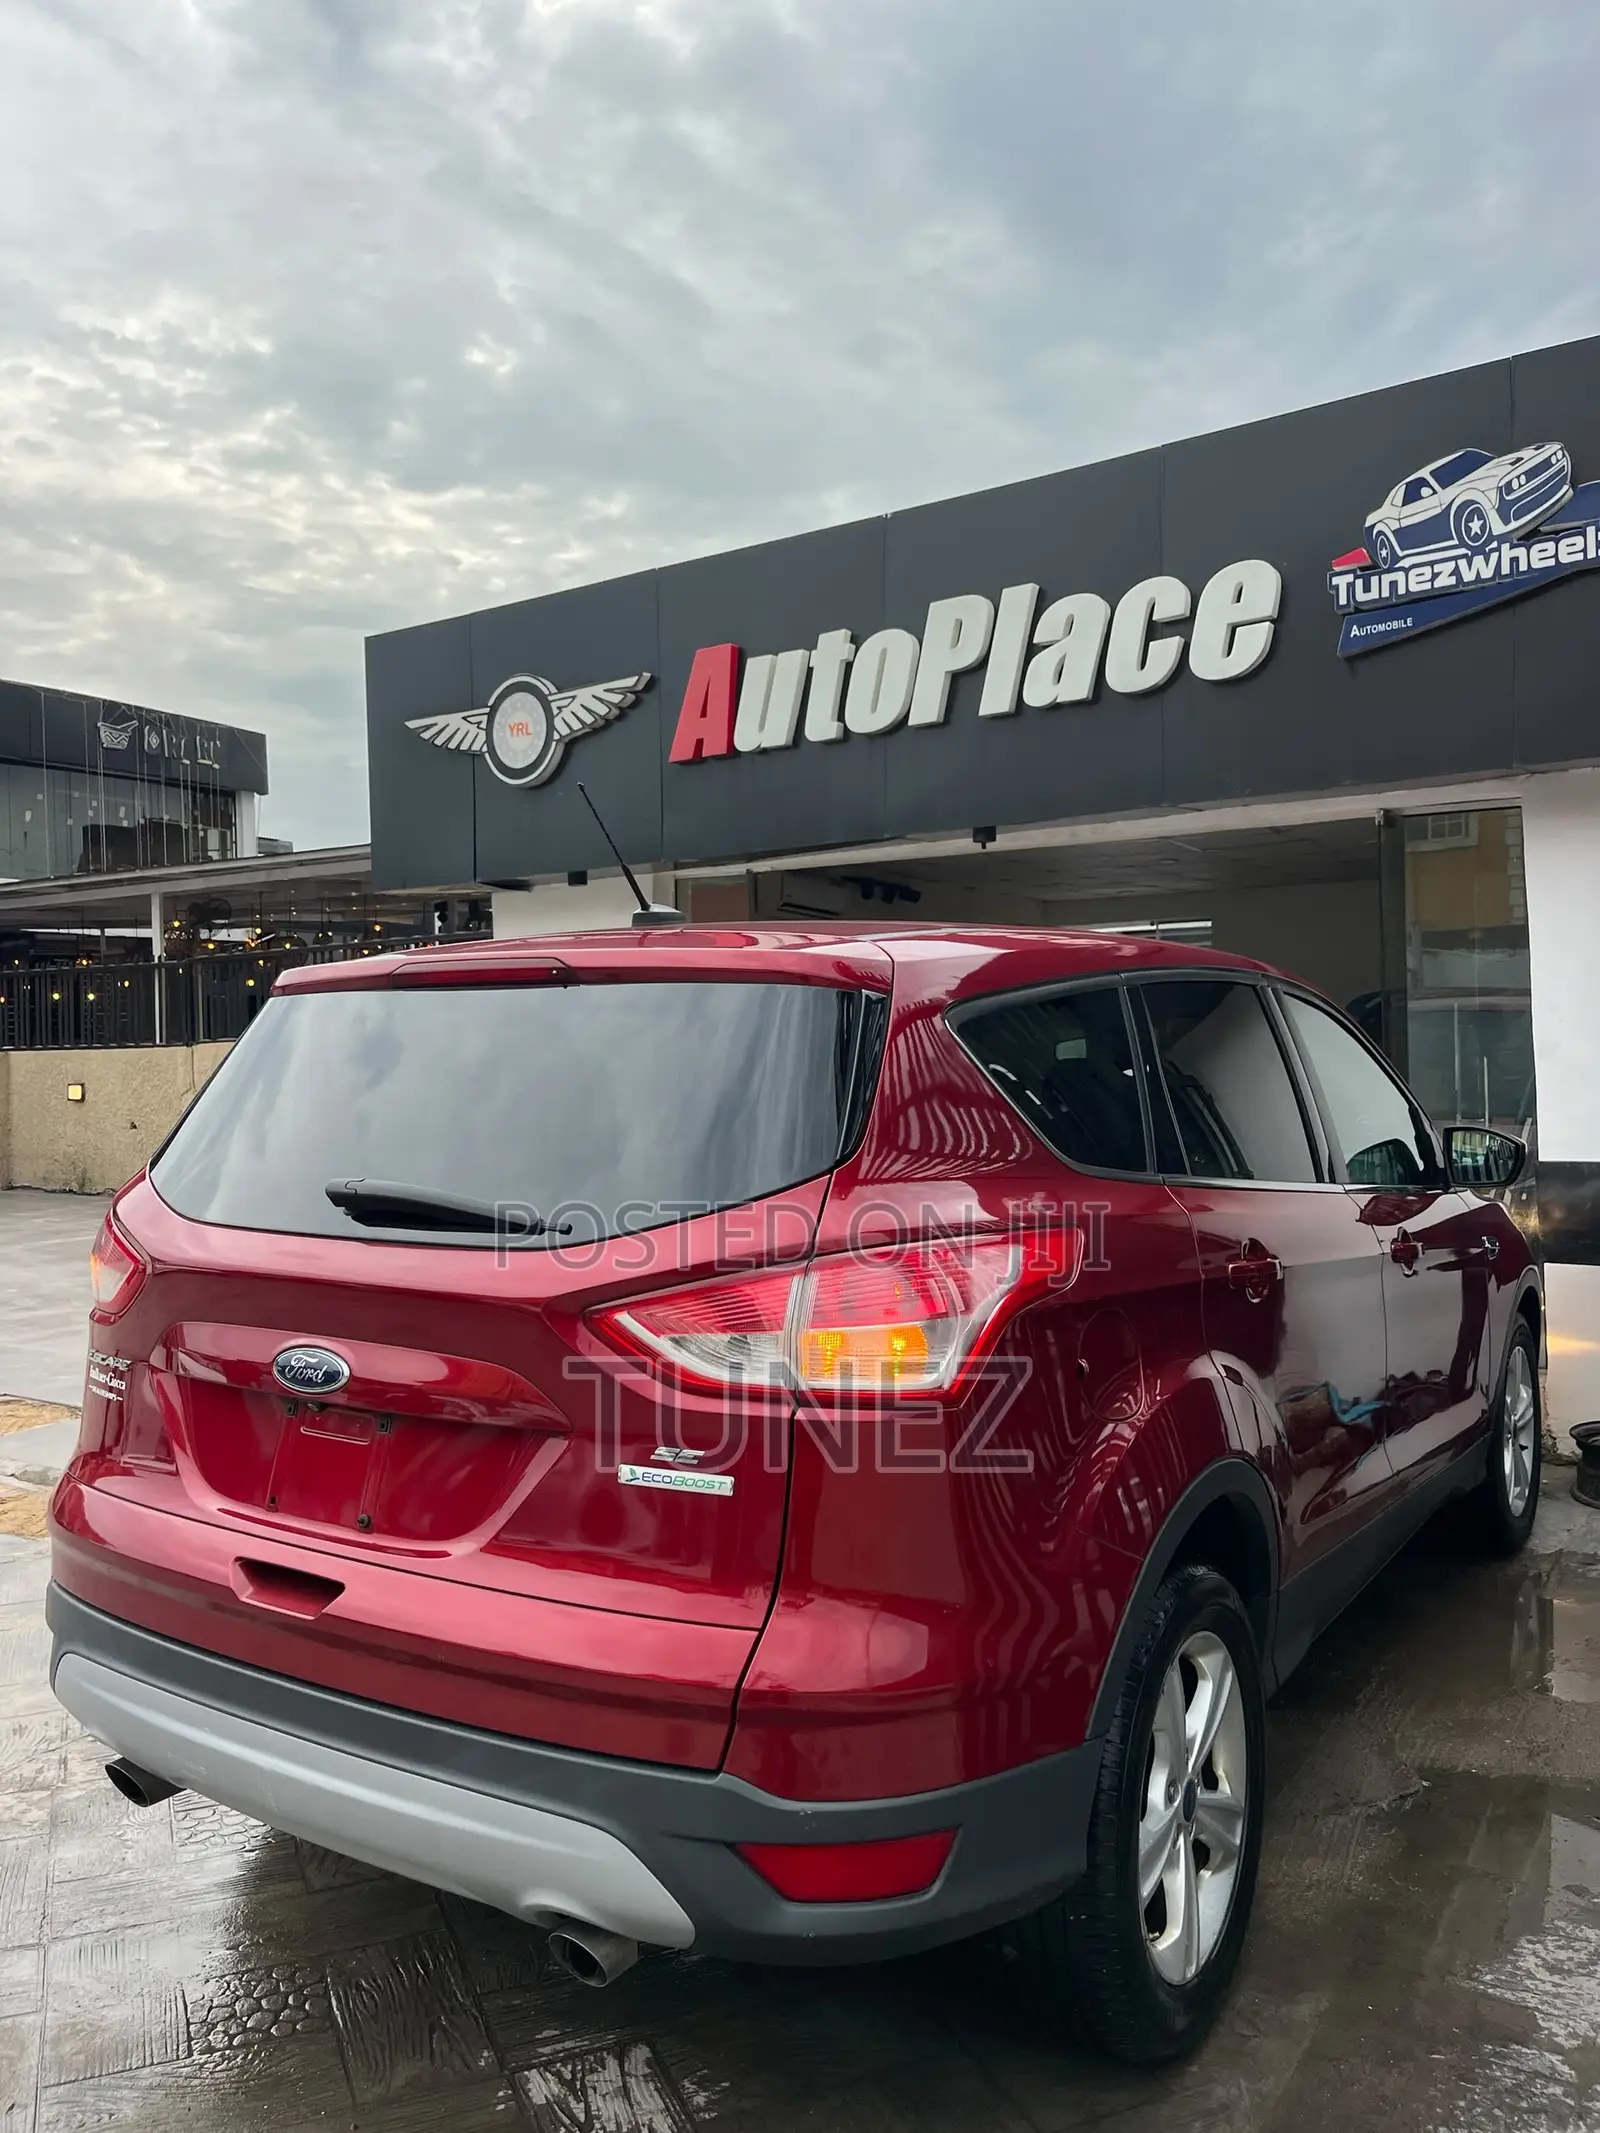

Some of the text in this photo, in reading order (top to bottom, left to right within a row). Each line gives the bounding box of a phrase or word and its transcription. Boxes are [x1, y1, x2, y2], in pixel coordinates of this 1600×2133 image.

[1332, 526, 1600, 606] Tunezwheel
[668, 559, 1282, 763] AutoPlace
[508, 721, 532, 737] YRL
[285, 1354, 329, 1383] Ford
[650, 1446, 706, 1464] SE
[641, 1471, 728, 1490] ECOBOOST
